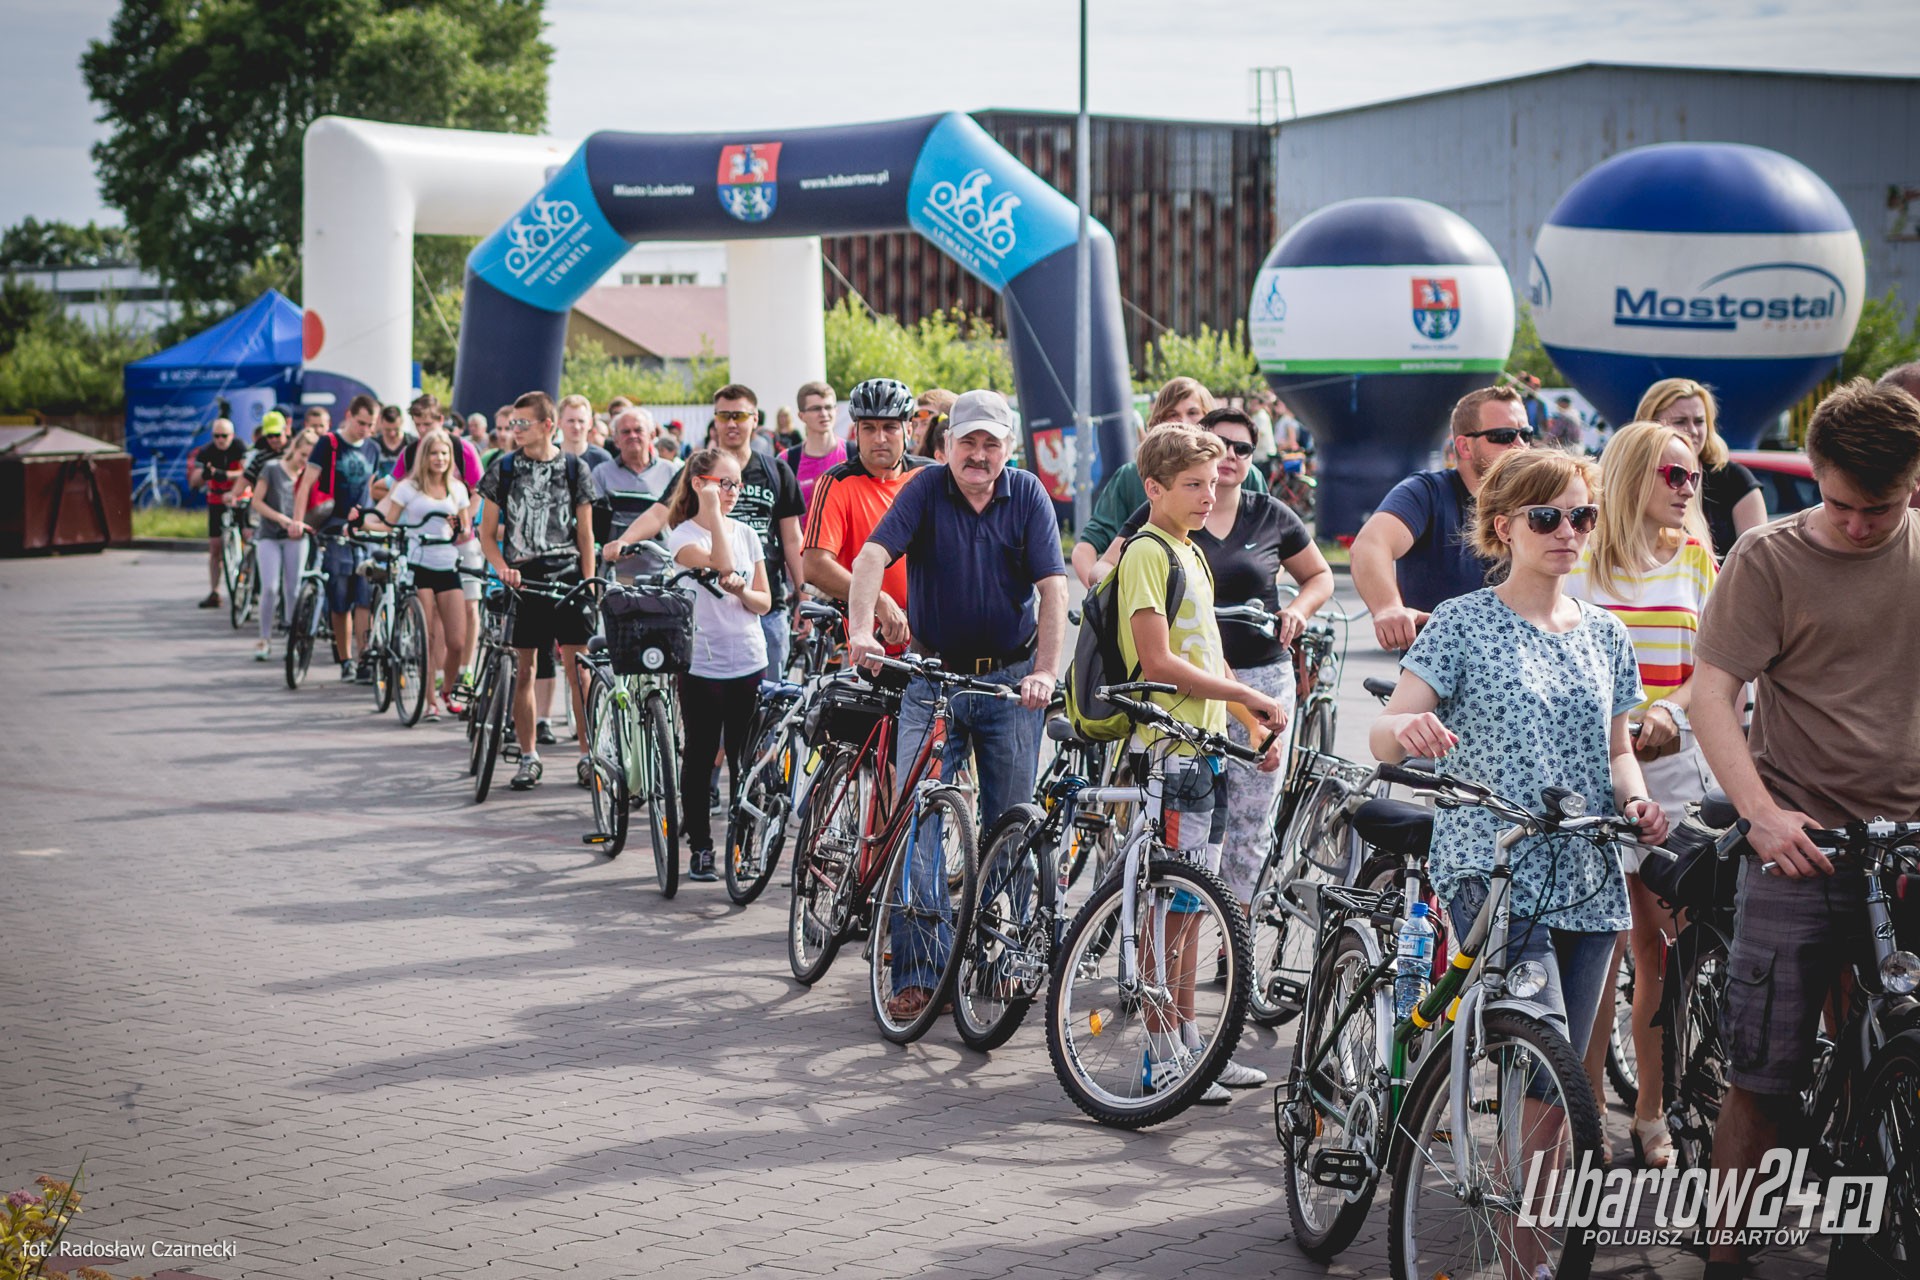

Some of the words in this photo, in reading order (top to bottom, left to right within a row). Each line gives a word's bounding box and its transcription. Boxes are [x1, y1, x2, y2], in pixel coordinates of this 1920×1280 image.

[646, 182, 696, 197] Lubartów
[800, 170, 890, 190] www.lubartow.pl
[545, 242, 593, 285] LEWARTA
[933, 226, 980, 269] LEWARTA
[1615, 286, 1836, 321] Mostostal
